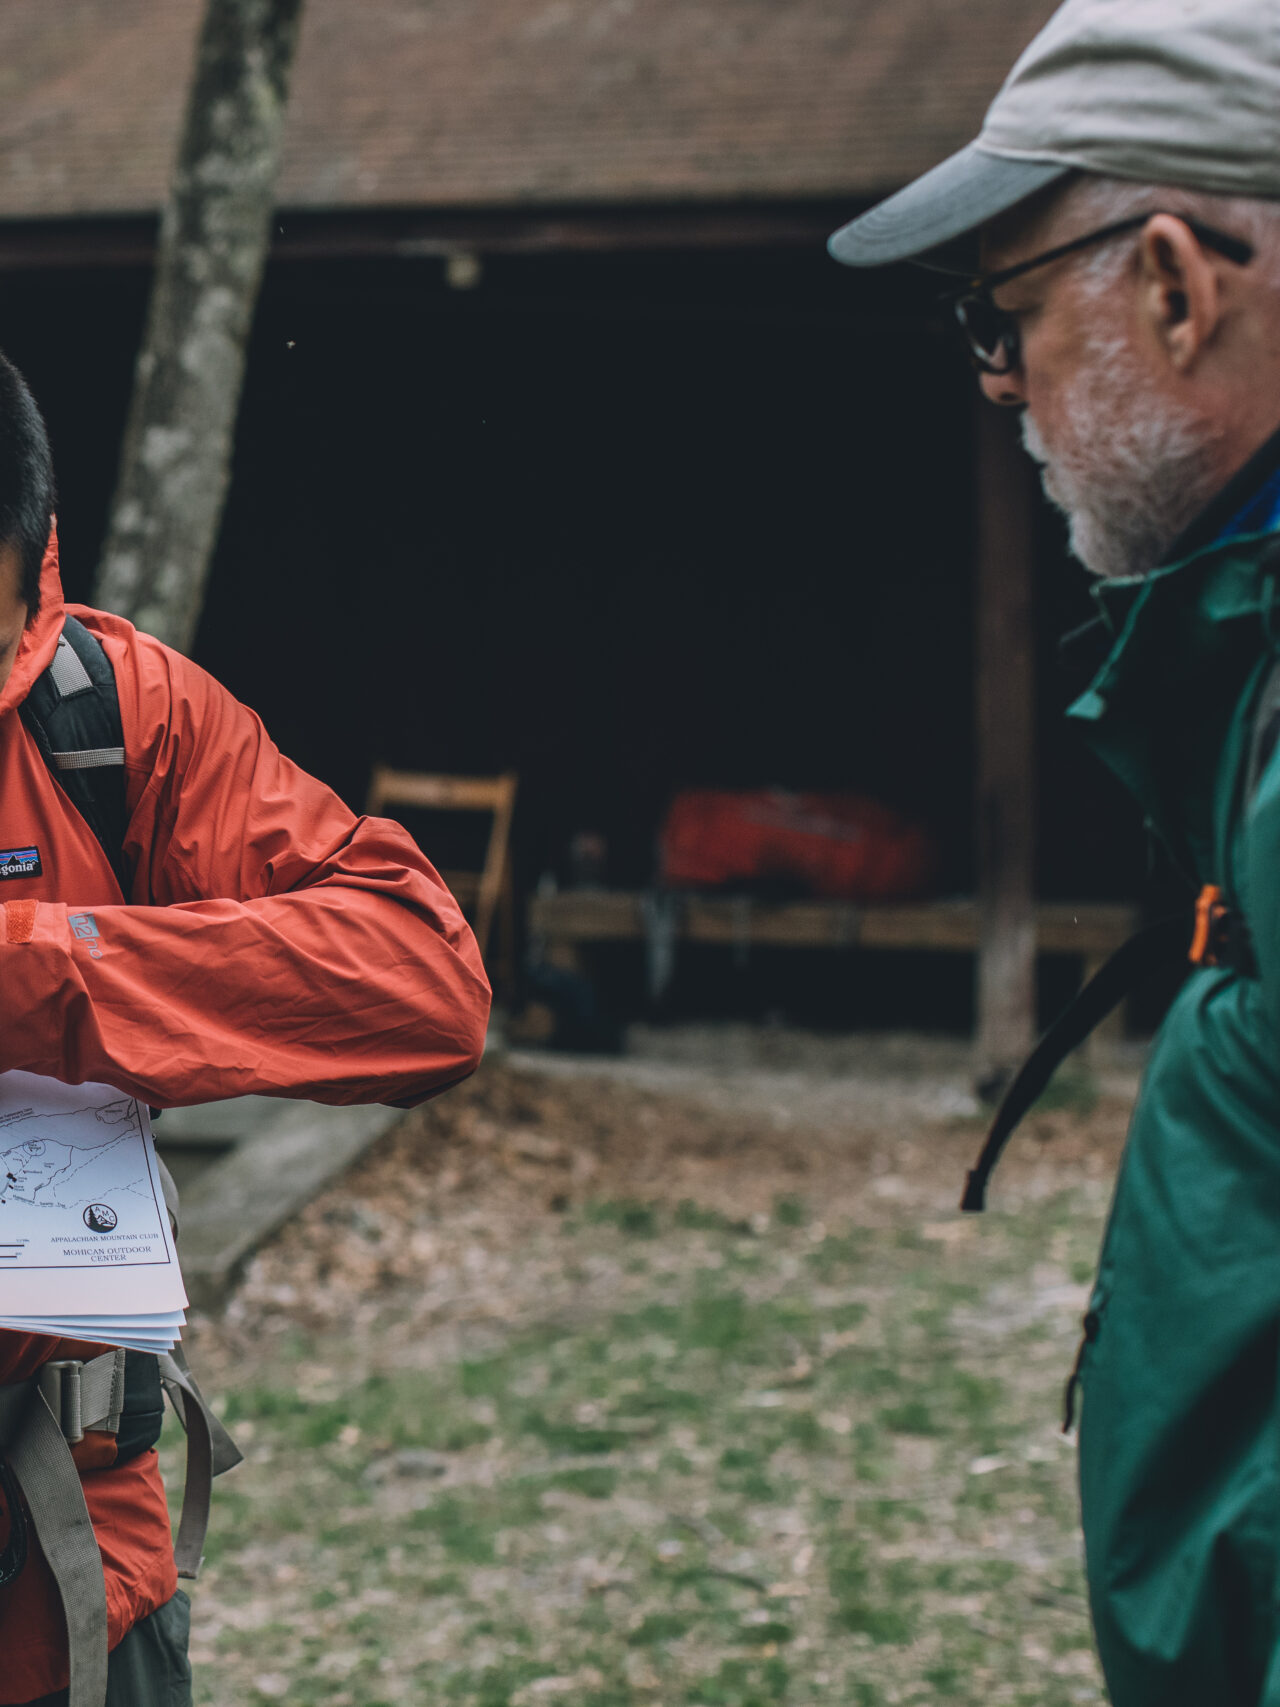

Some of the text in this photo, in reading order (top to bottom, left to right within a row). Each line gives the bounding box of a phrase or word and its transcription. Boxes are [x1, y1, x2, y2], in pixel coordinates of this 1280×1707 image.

[63, 1246, 151, 1256] MOHICAN OUTDOOR
[90, 1254, 127, 1262] CENTER
